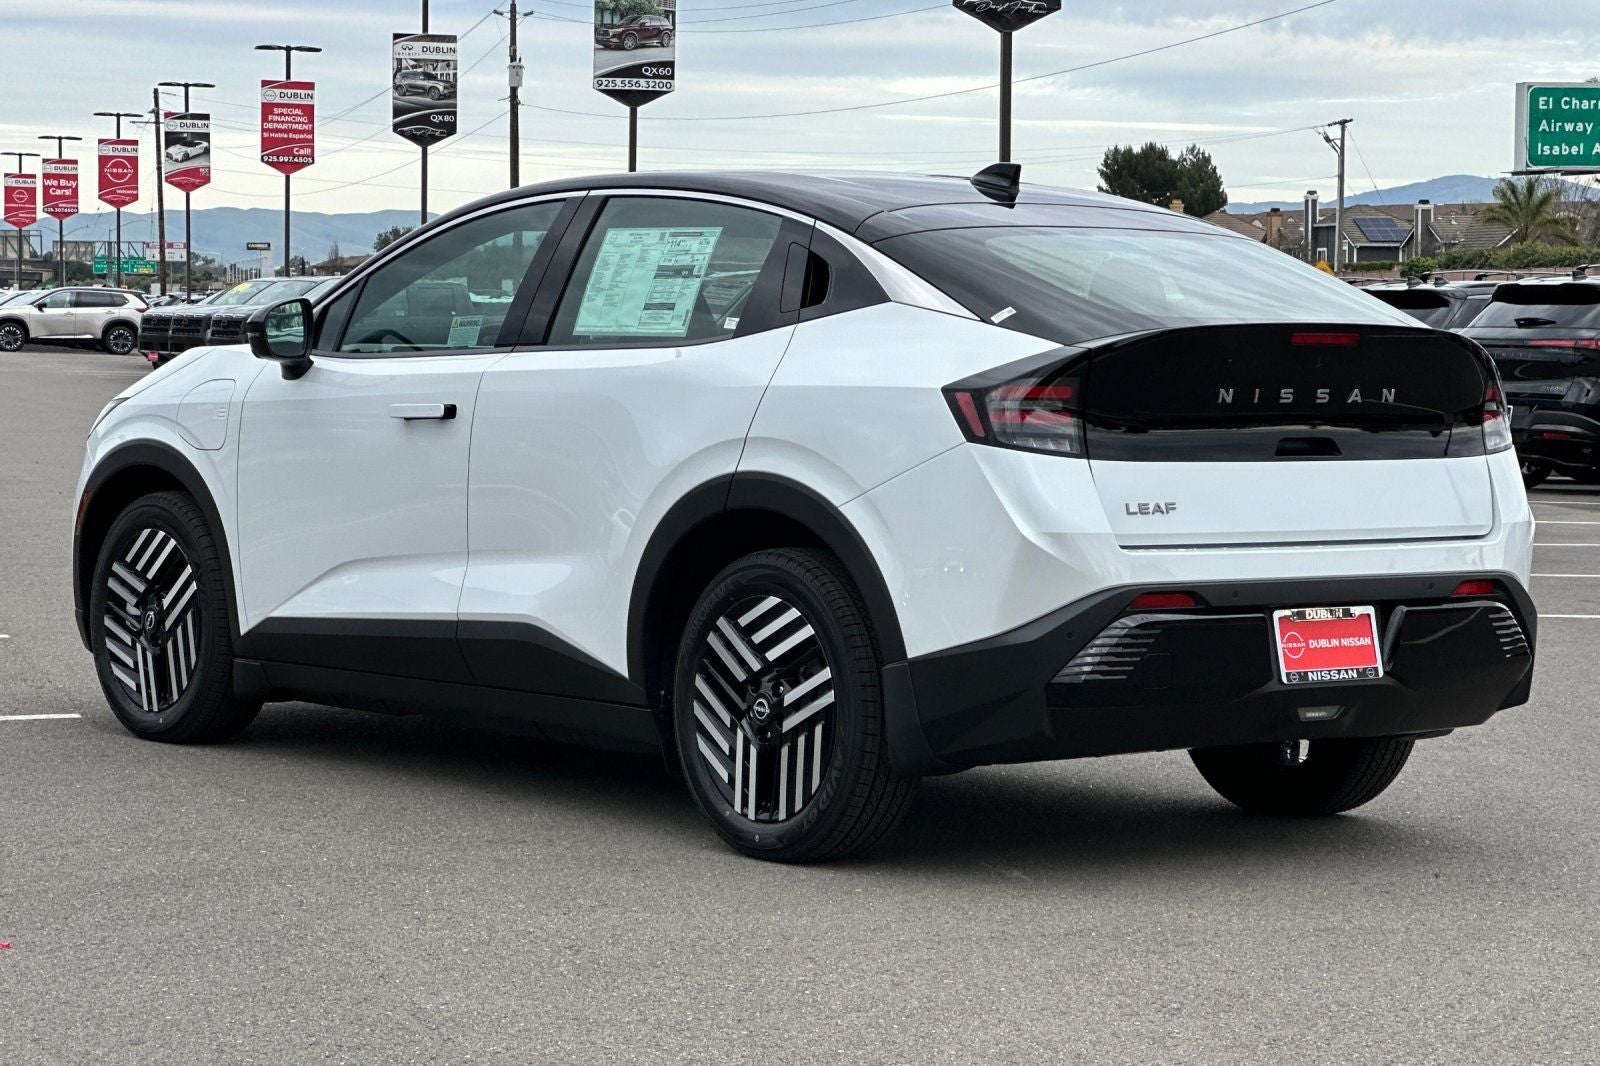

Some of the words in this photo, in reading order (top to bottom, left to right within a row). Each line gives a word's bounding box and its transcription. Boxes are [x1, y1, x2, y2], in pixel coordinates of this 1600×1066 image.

[421, 45, 456, 55] DUBLIN
[642, 66, 672, 76] QX60
[596, 79, 673, 90] 925.556.3200
[279, 91, 314, 100] DUBLIN
[1538, 97, 1553, 109] El
[273, 107, 304, 115] SPECIAL
[268, 115, 308, 123] FINANCING
[430, 114, 455, 123] QX80
[179, 121, 209, 129] DUBLIN
[263, 122, 313, 130] DEPARTMENT
[1538, 119, 1594, 135] Airway
[293, 147, 311, 155] Call!
[1537, 142, 1584, 155] Isabel
[263, 155, 313, 163] 925.997.4505
[44, 178, 58, 187] We
[59, 179, 78, 189] Buy
[49, 187, 72, 196] Cars!
[1217, 388, 1396, 404] NISSAN
[1125, 501, 1177, 516] LEAF
[1305, 608, 1343, 619] DUBLIN
[1308, 638, 1340, 649] DUBLIN
[1341, 636, 1371, 647] NISSAN
[1307, 668, 1358, 681] NISSAN
